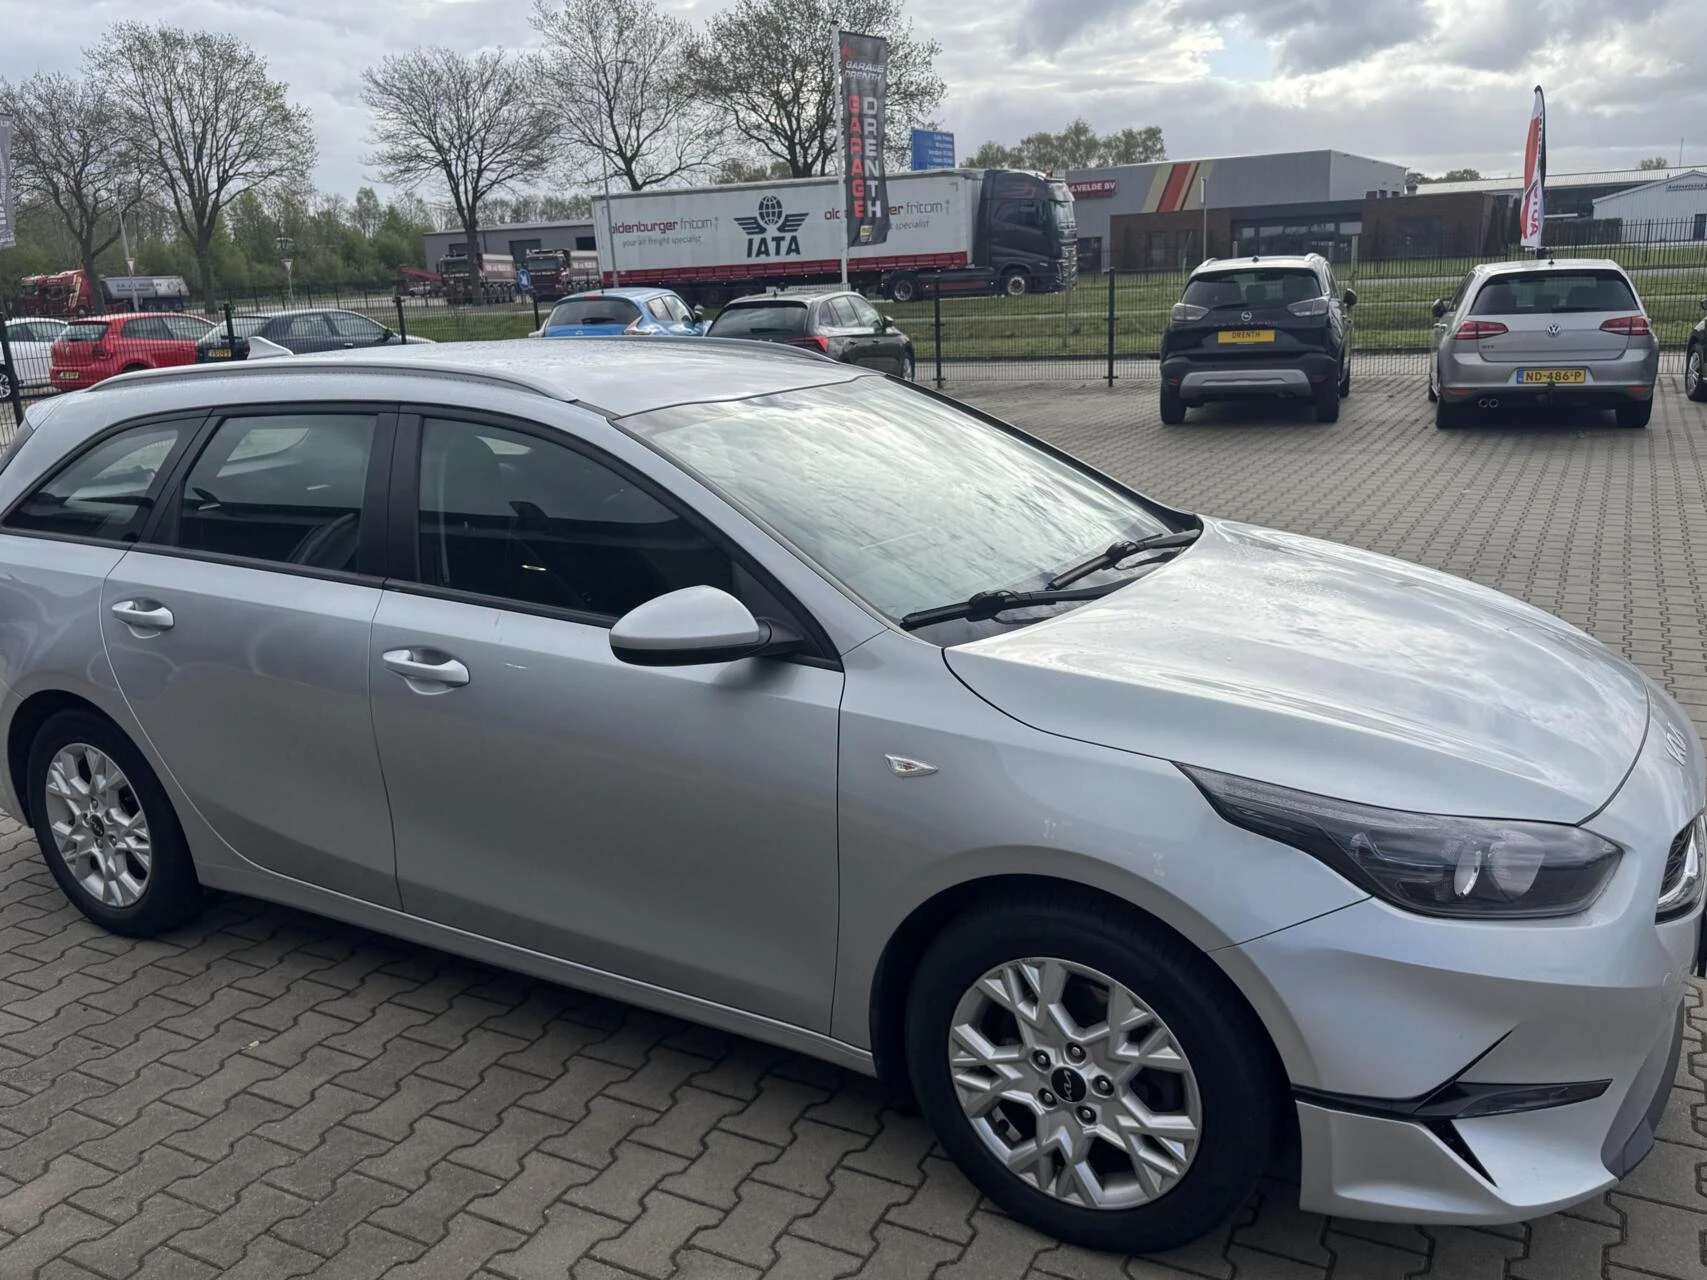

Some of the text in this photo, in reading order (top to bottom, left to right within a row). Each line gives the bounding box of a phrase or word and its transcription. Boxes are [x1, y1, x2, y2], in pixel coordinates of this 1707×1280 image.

[844, 70, 882, 81] DRENTH
[849, 96, 865, 218] GARAGE
[863, 97, 882, 218] DRENTH
[906, 201, 943, 215] fritom
[895, 219, 929, 231] specialist
[747, 235, 801, 258] IATA
[1525, 371, 1582, 381] ND-486-P
